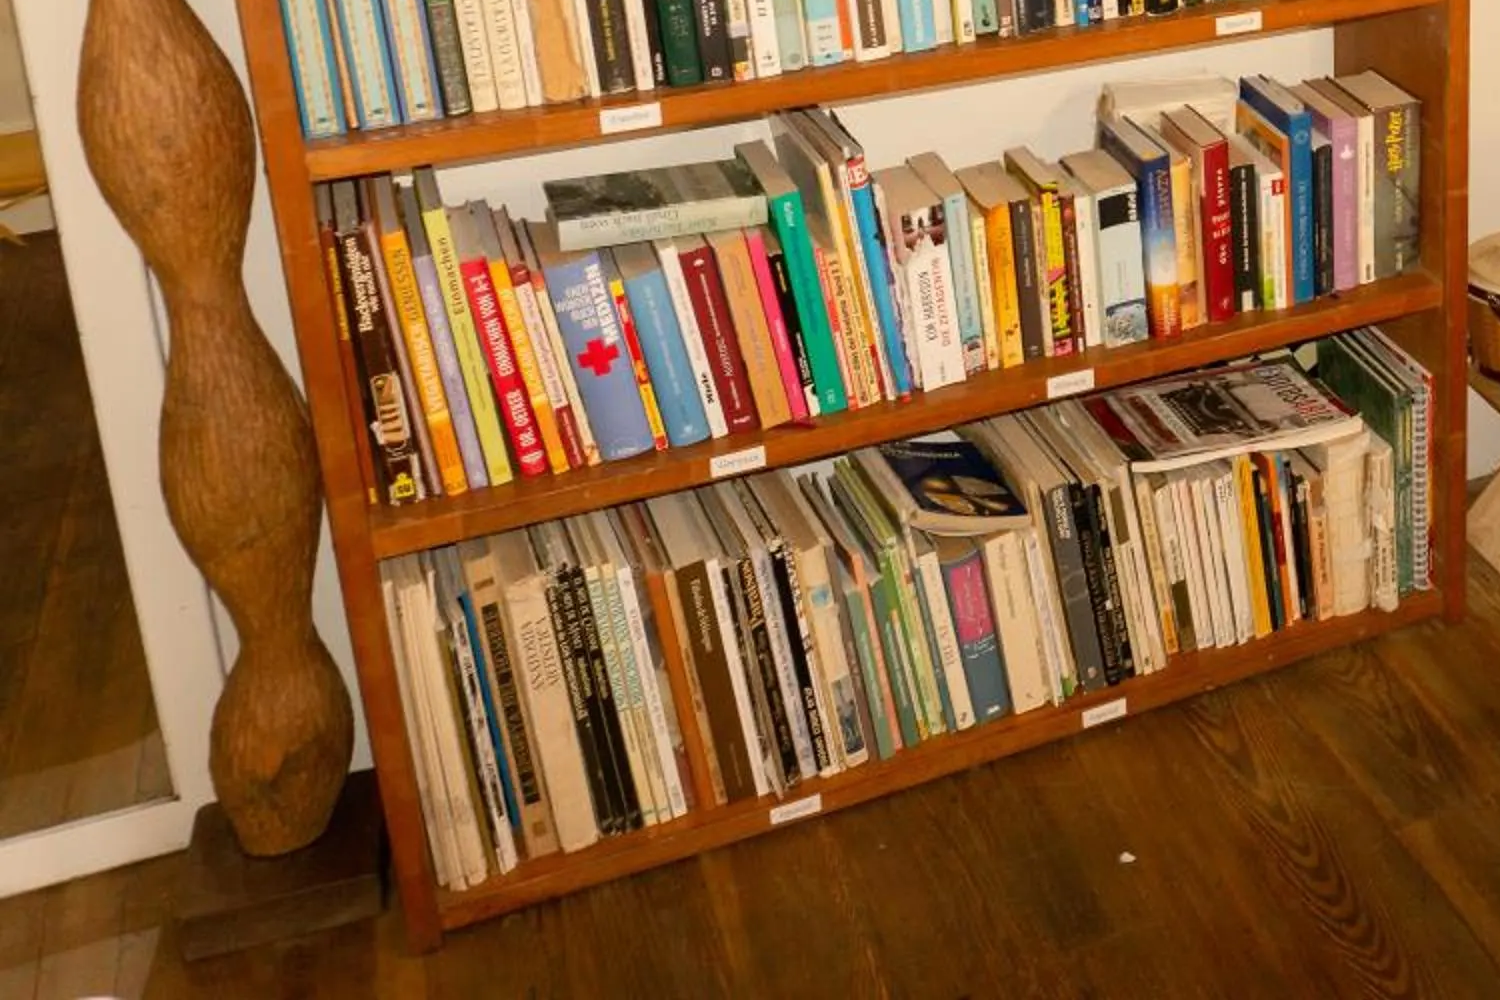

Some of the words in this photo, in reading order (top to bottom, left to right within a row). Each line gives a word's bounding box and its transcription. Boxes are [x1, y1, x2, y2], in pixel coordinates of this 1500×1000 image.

[1383, 111, 1402, 142] Potter
[1386, 143, 1402, 170] Harry
[344, 236, 374, 332] Backvergnügen
[438, 236, 465, 315] Einmachen
[584, 263, 619, 347] MEDIZIN
[916, 271, 936, 320] HARRISON
